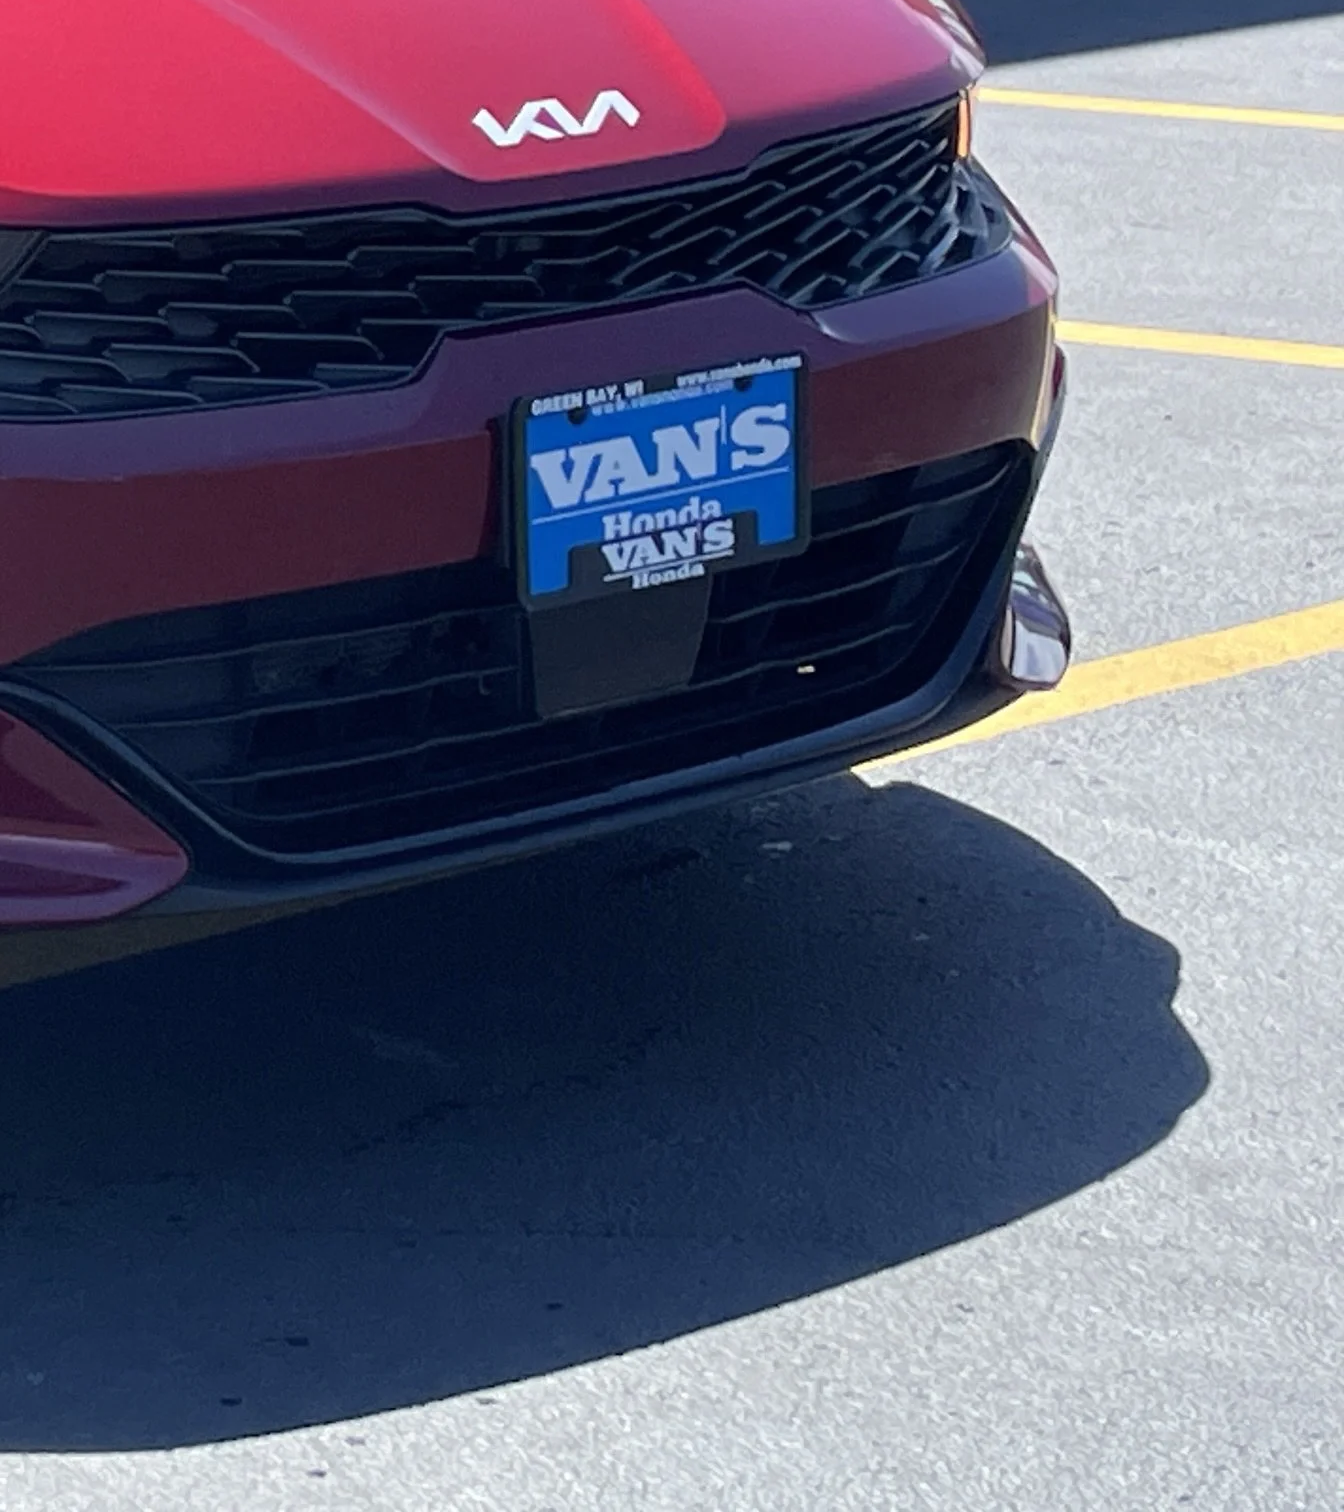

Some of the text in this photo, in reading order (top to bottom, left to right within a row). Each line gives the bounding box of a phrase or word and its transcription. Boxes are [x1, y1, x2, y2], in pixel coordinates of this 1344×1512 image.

[472, 90, 640, 146] KIA
[531, 391, 583, 416] GREEN
[602, 496, 722, 541] Honda
[632, 562, 705, 589] Honda
